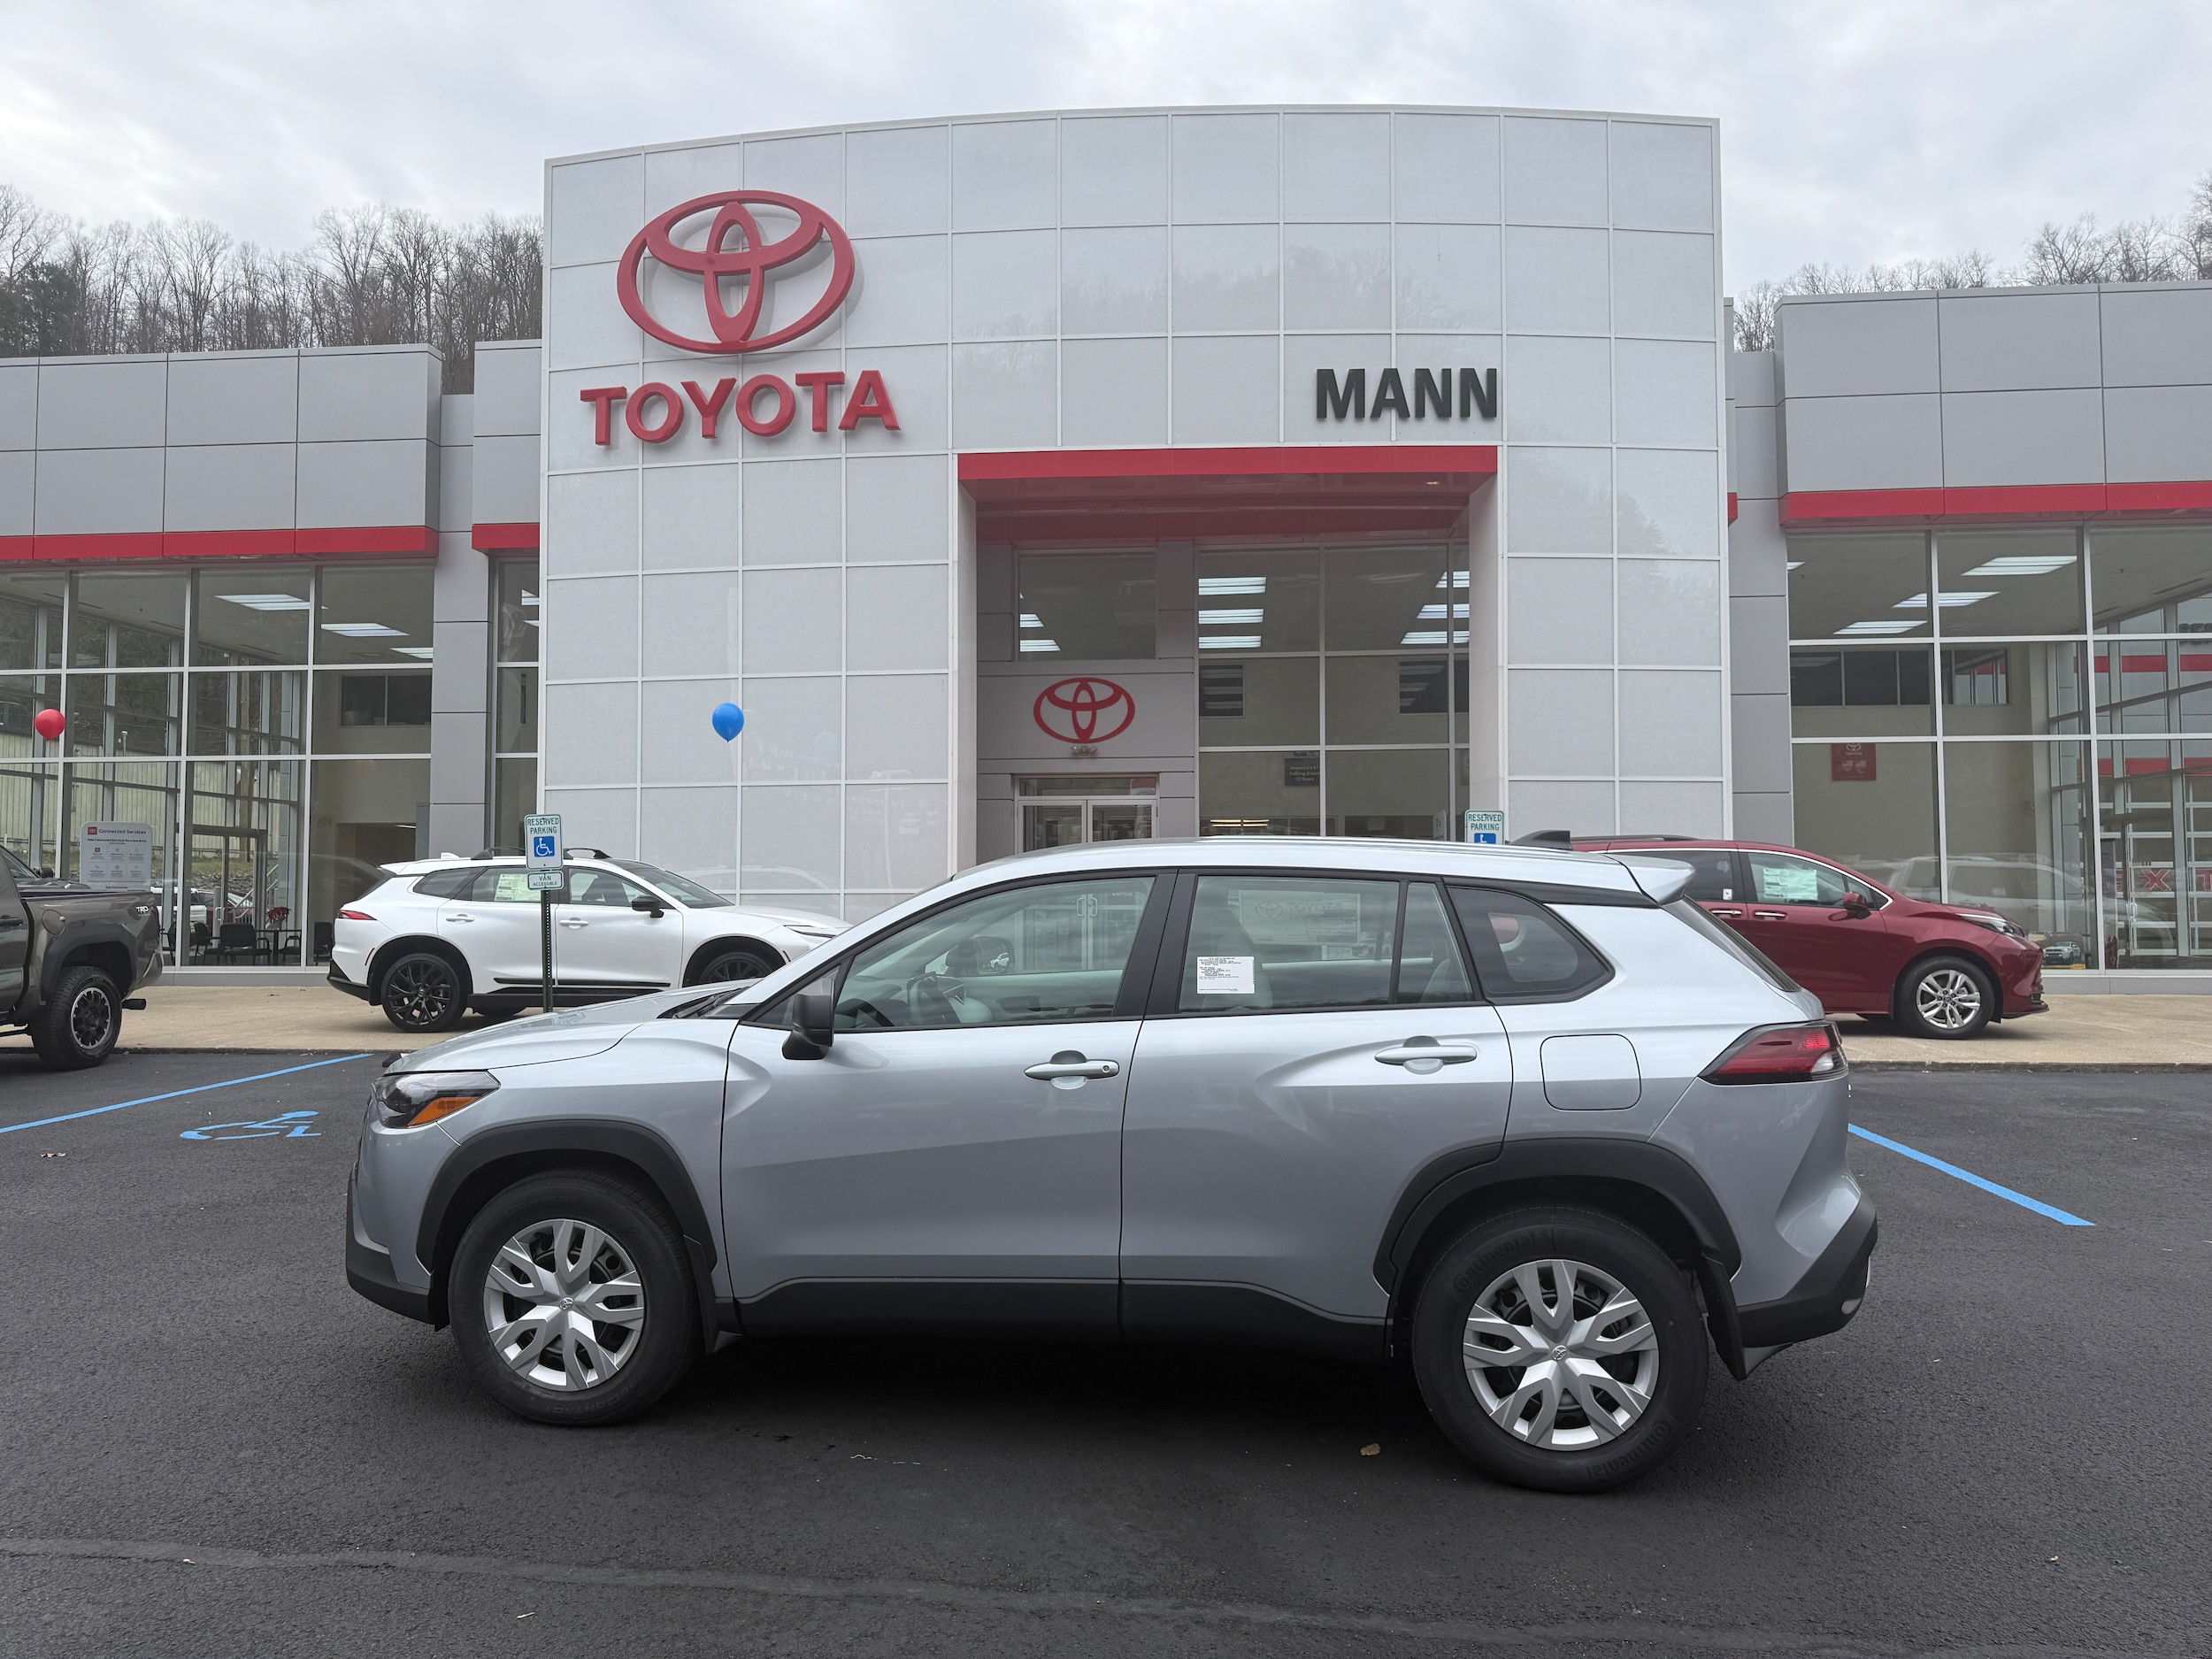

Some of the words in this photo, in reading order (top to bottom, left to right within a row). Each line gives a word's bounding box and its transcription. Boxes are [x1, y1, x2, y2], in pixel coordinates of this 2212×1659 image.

[580, 370, 901, 446] TOYOTA
[1317, 368, 1497, 419] MANN
[526, 818, 559, 826] RESERVED
[1468, 813, 1502, 822] RESERVED
[1454, 1231, 1536, 1293] Continental
[1586, 1420, 1672, 1476] Continental
